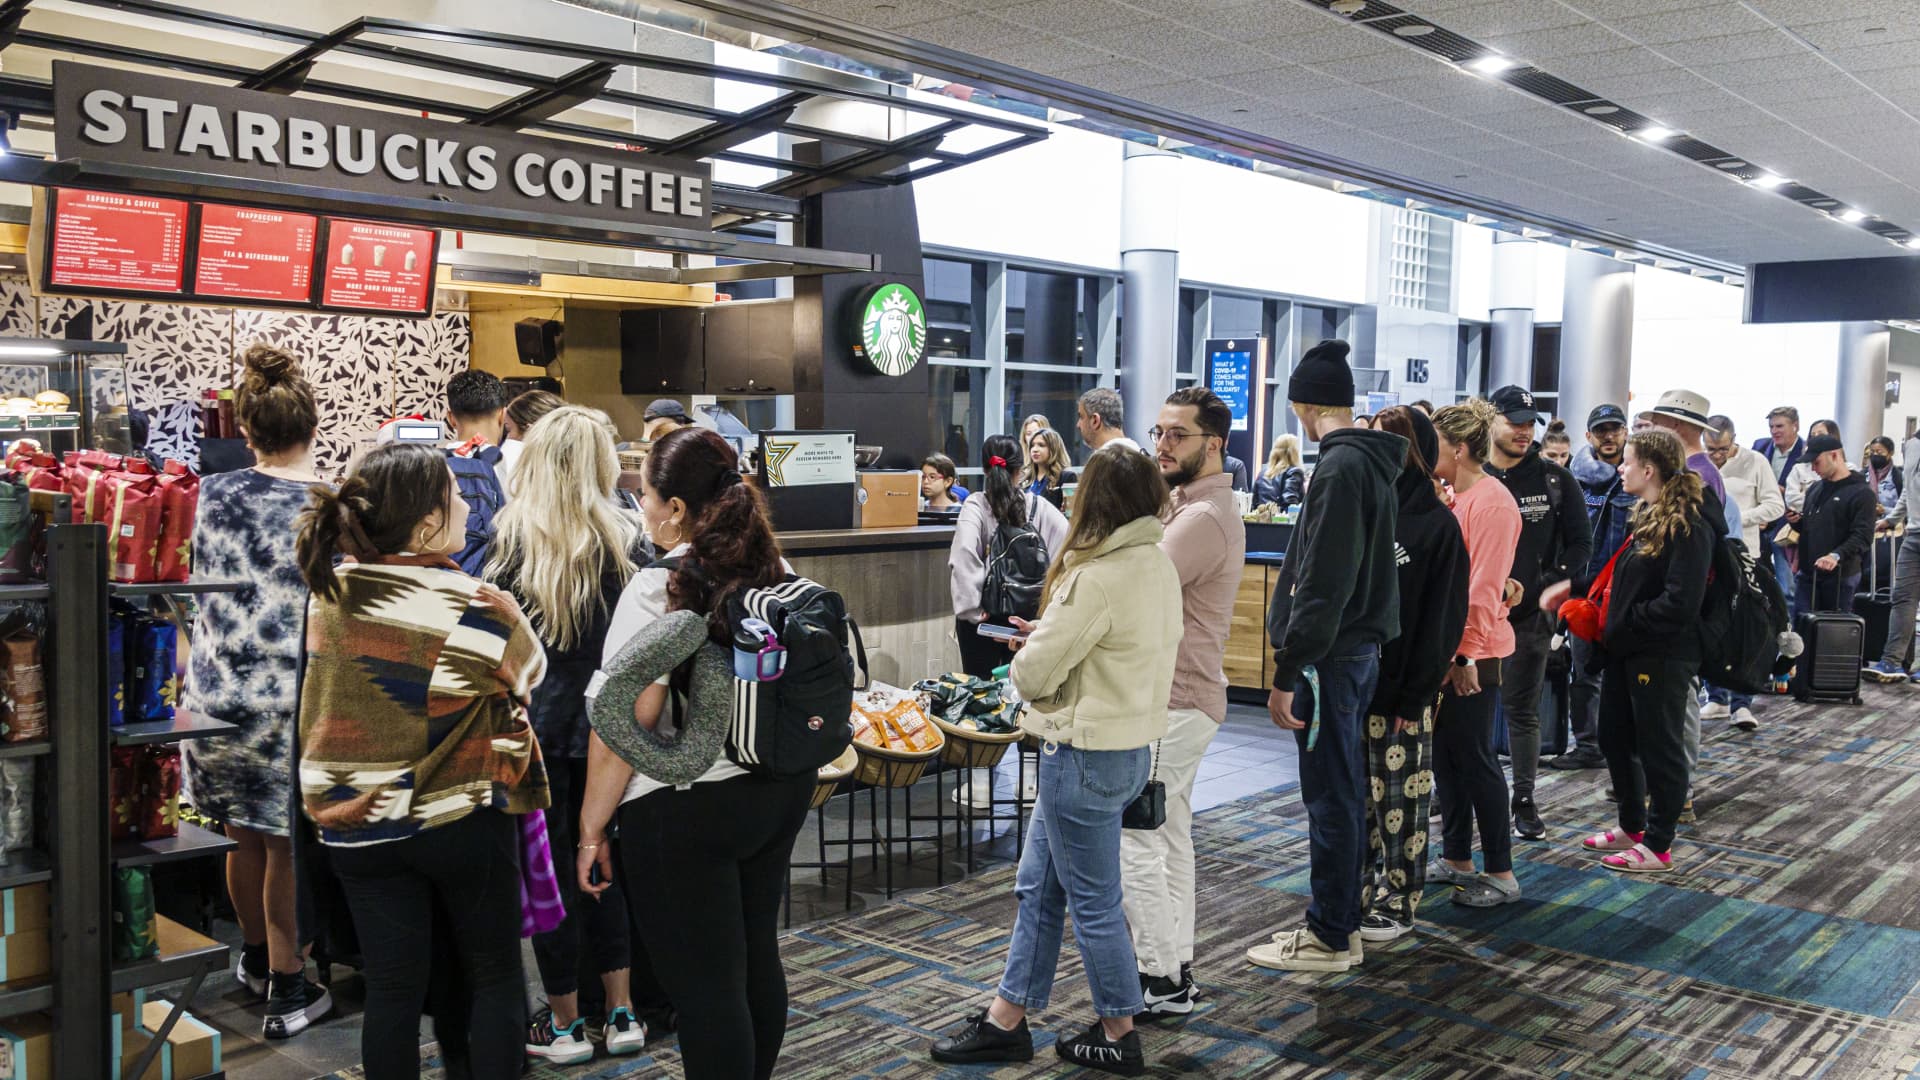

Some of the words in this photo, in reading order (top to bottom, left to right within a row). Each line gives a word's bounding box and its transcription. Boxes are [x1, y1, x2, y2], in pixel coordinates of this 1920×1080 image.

[82, 89, 497, 192] STARBUCKS
[513, 153, 703, 217] COFFEE
[86, 194, 124, 205] ESPRESSO
[134, 200, 159, 209] COFFEE
[223, 250, 235, 258] TEA
[1520, 494, 1547, 504] TOKYO
